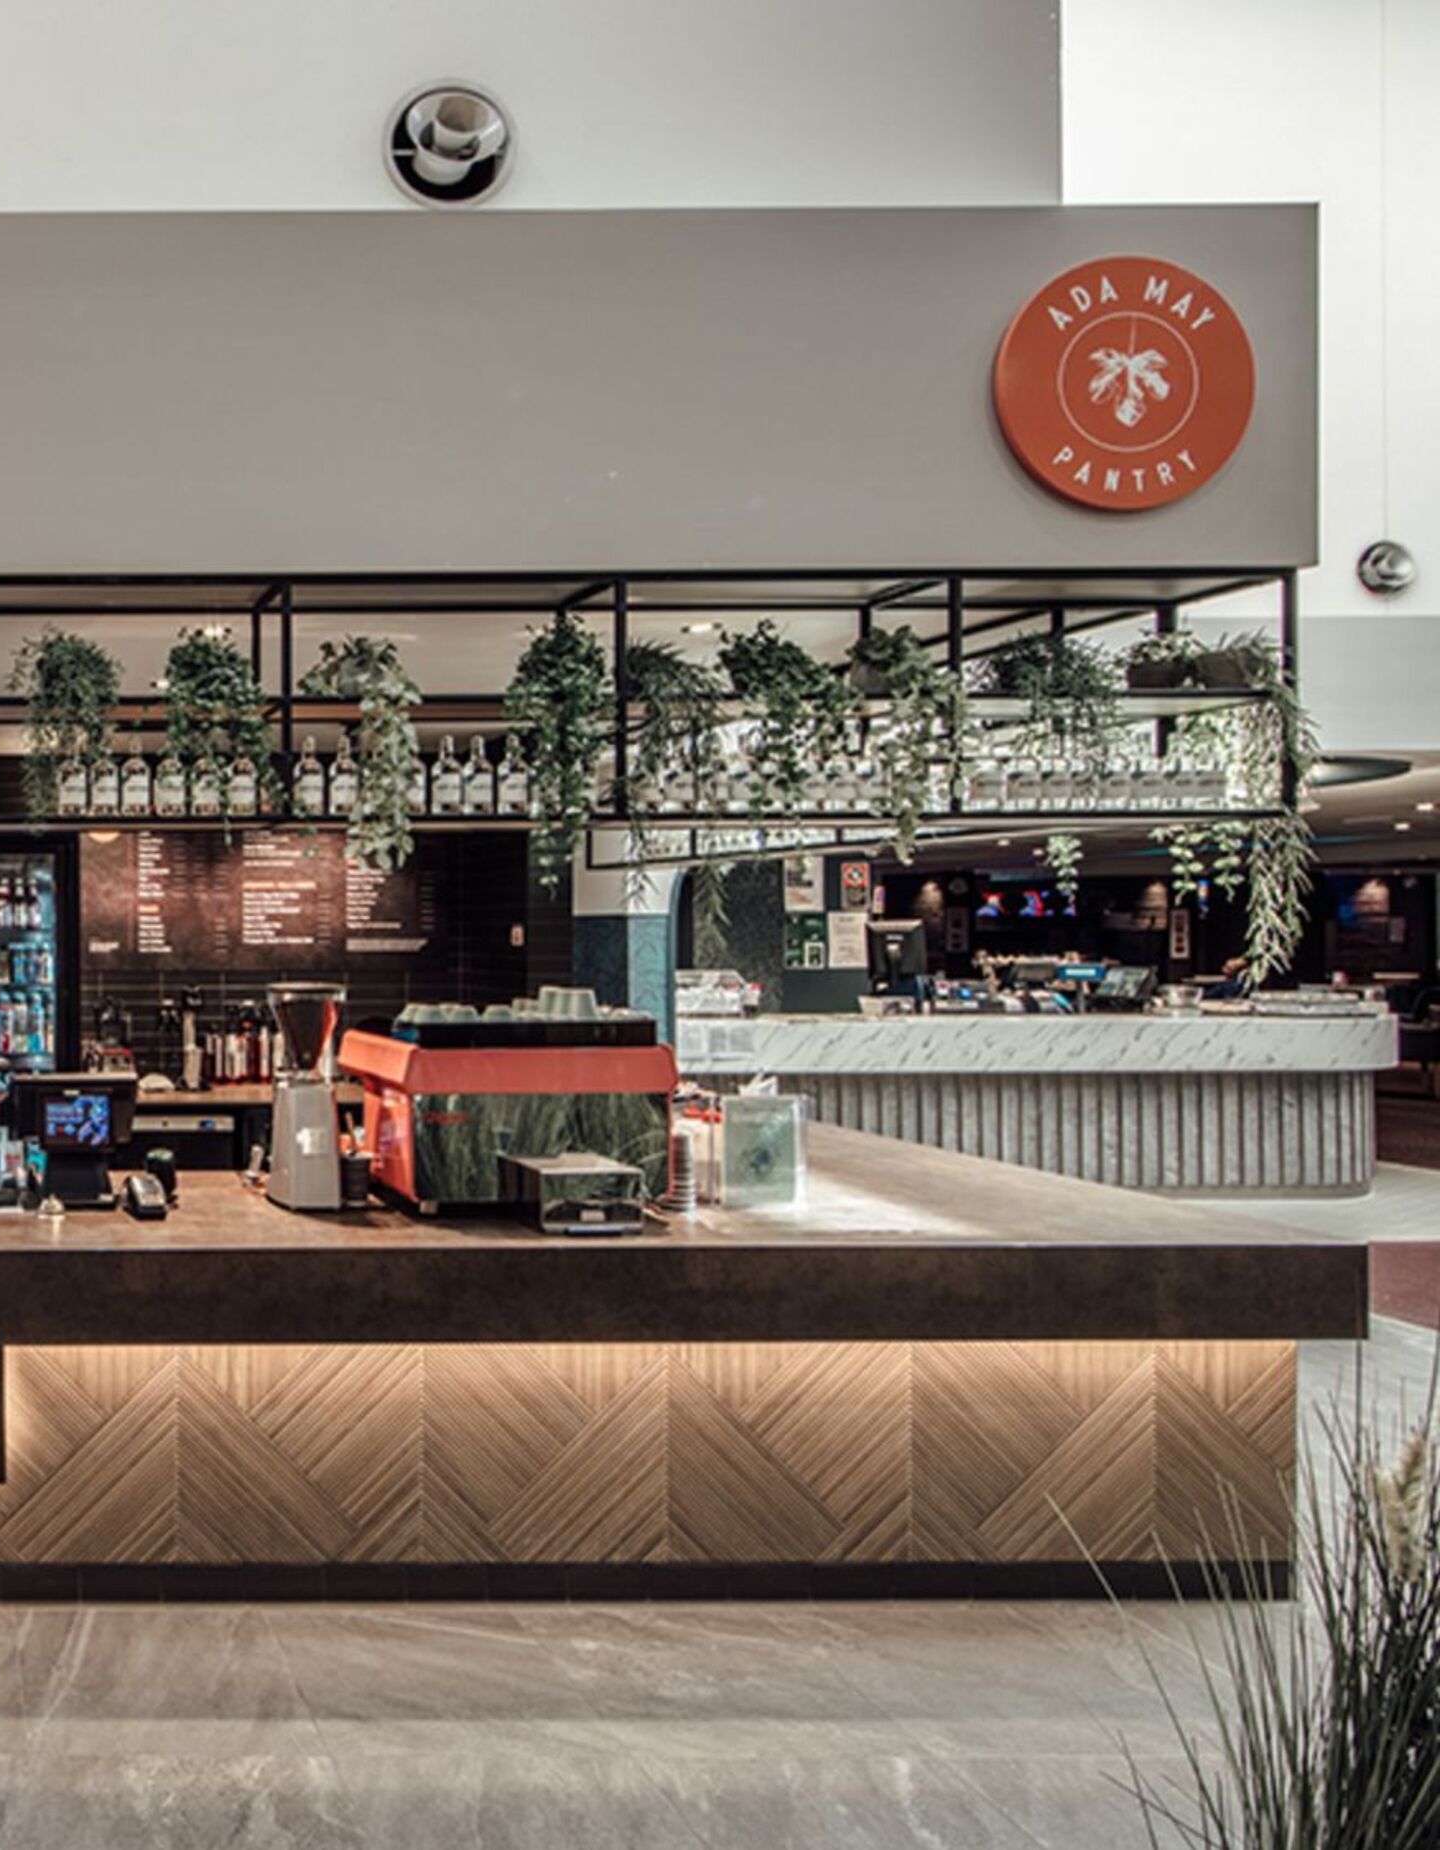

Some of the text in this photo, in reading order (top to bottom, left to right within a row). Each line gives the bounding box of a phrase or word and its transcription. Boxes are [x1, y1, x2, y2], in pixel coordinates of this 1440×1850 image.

[1047, 275, 1216, 331] ADA MAY
[1052, 446, 1197, 492] PANTRY
